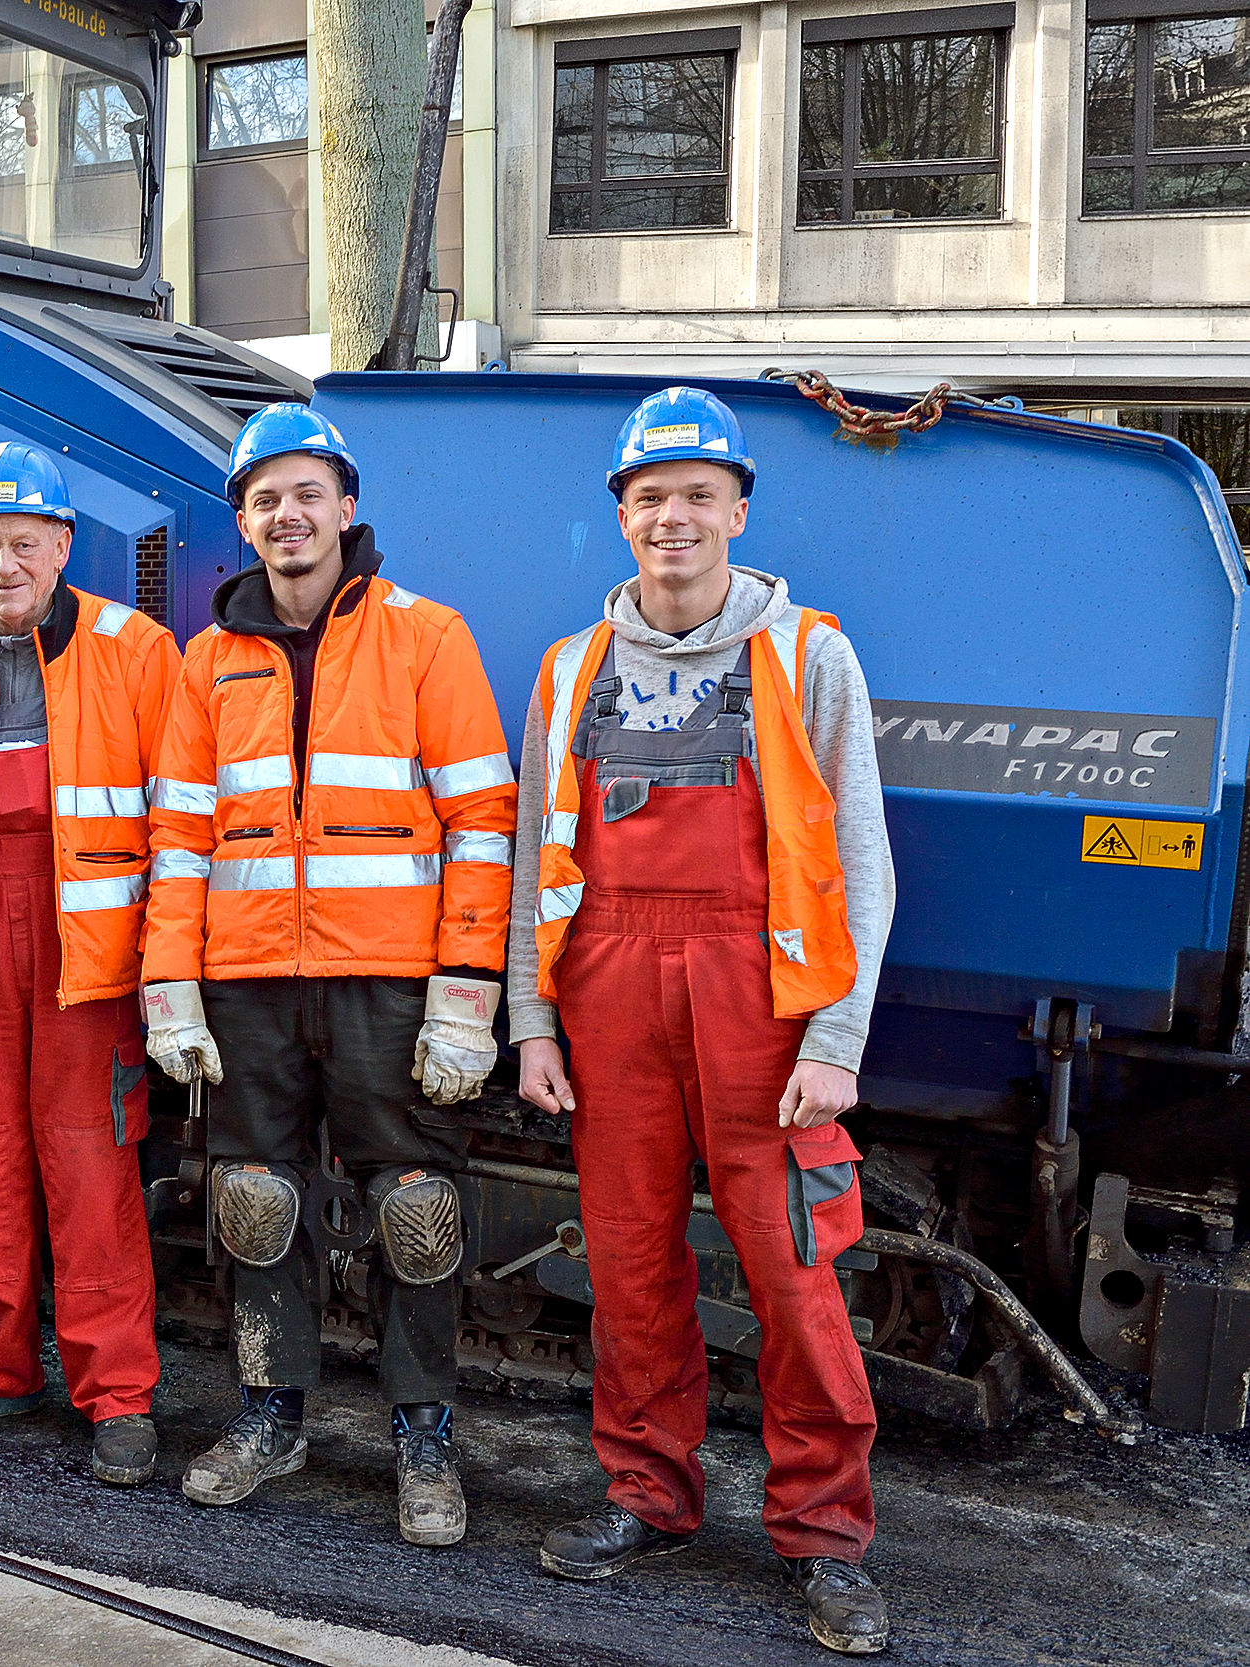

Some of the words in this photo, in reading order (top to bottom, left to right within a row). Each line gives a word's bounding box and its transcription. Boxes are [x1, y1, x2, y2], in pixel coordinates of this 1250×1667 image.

[646, 425, 696, 436] STRA-LA-BAU
[872, 715, 1179, 758] YNAPAC
[1004, 759, 1156, 788] F1700C
[449, 988, 481, 999] CALCUTTA
